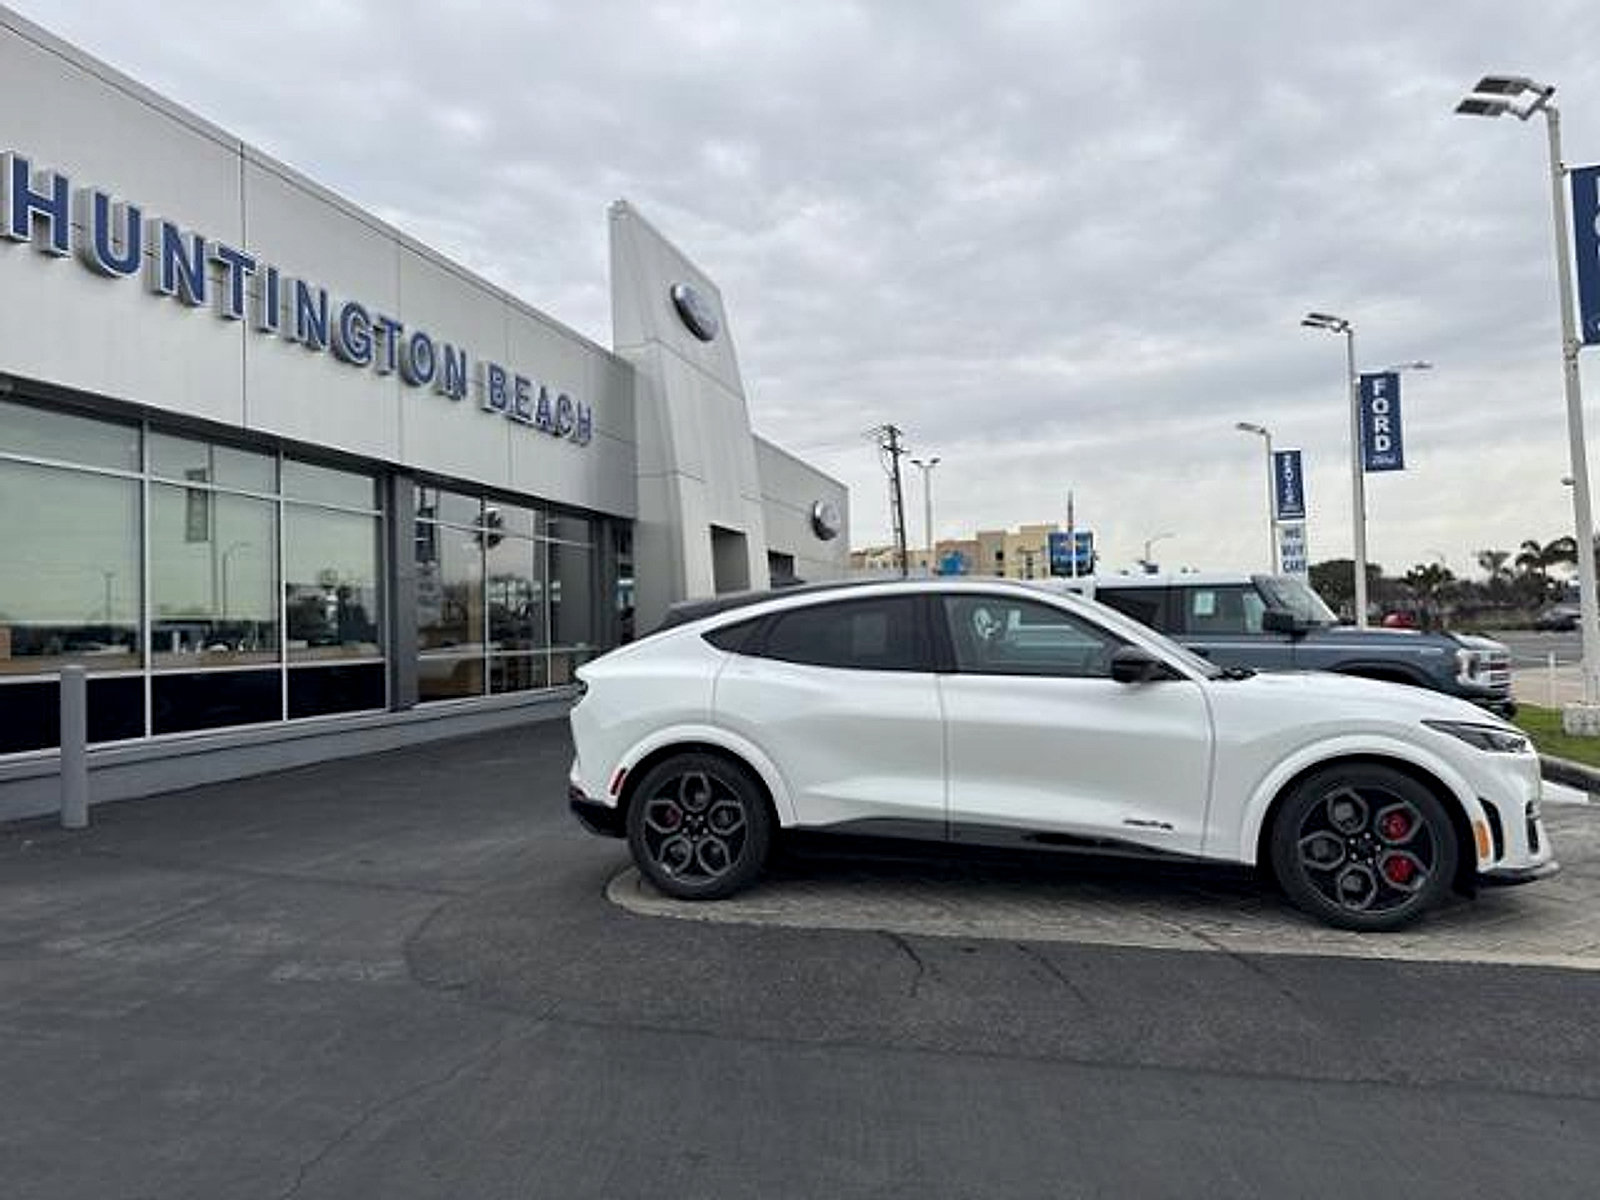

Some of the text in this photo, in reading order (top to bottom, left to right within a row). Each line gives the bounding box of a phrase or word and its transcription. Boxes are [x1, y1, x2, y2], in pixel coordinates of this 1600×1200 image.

[5, 152, 592, 445] HUNTINGTON BEACH
[1372, 377, 1391, 452] FORD
